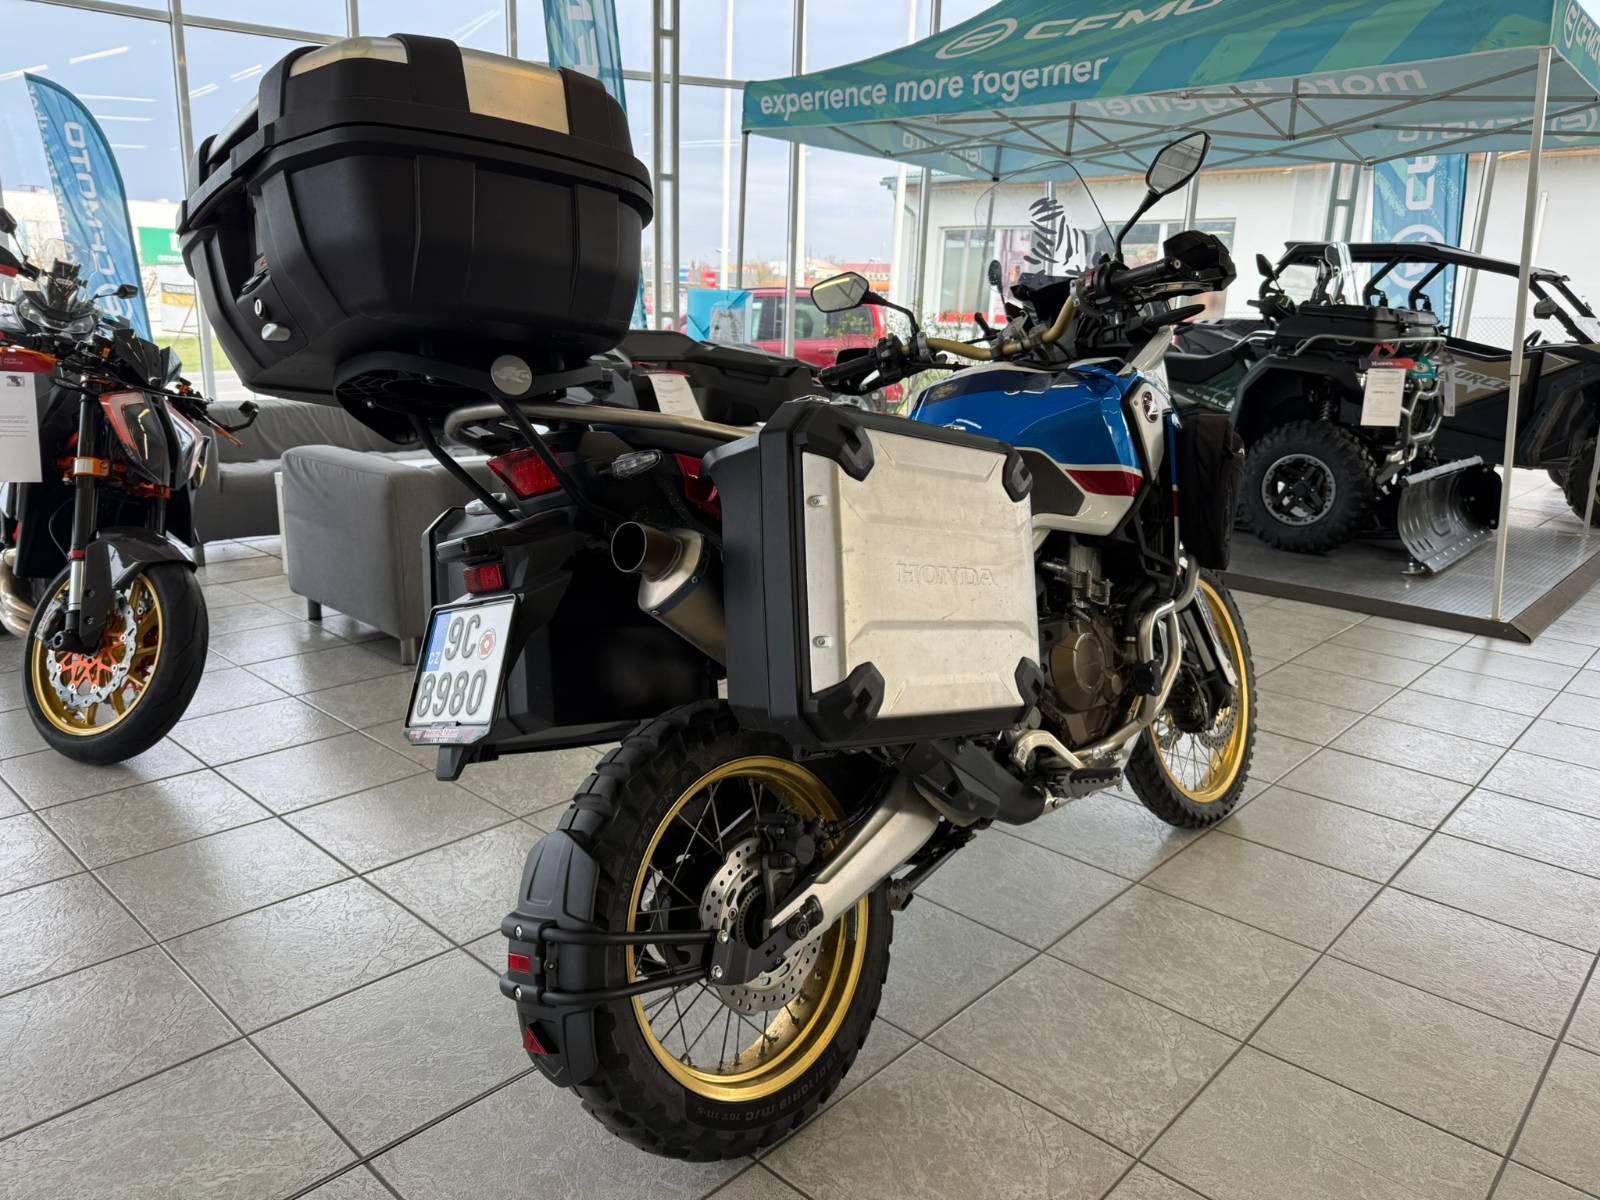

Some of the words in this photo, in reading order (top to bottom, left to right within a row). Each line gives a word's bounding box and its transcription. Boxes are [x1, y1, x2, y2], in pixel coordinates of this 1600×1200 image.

[760, 83, 888, 121] experience
[894, 75, 964, 103] more
[895, 562, 999, 586] HONDA
[428, 651, 441, 665] CZ
[444, 613, 481, 661] 9C
[416, 668, 488, 718] 8980
